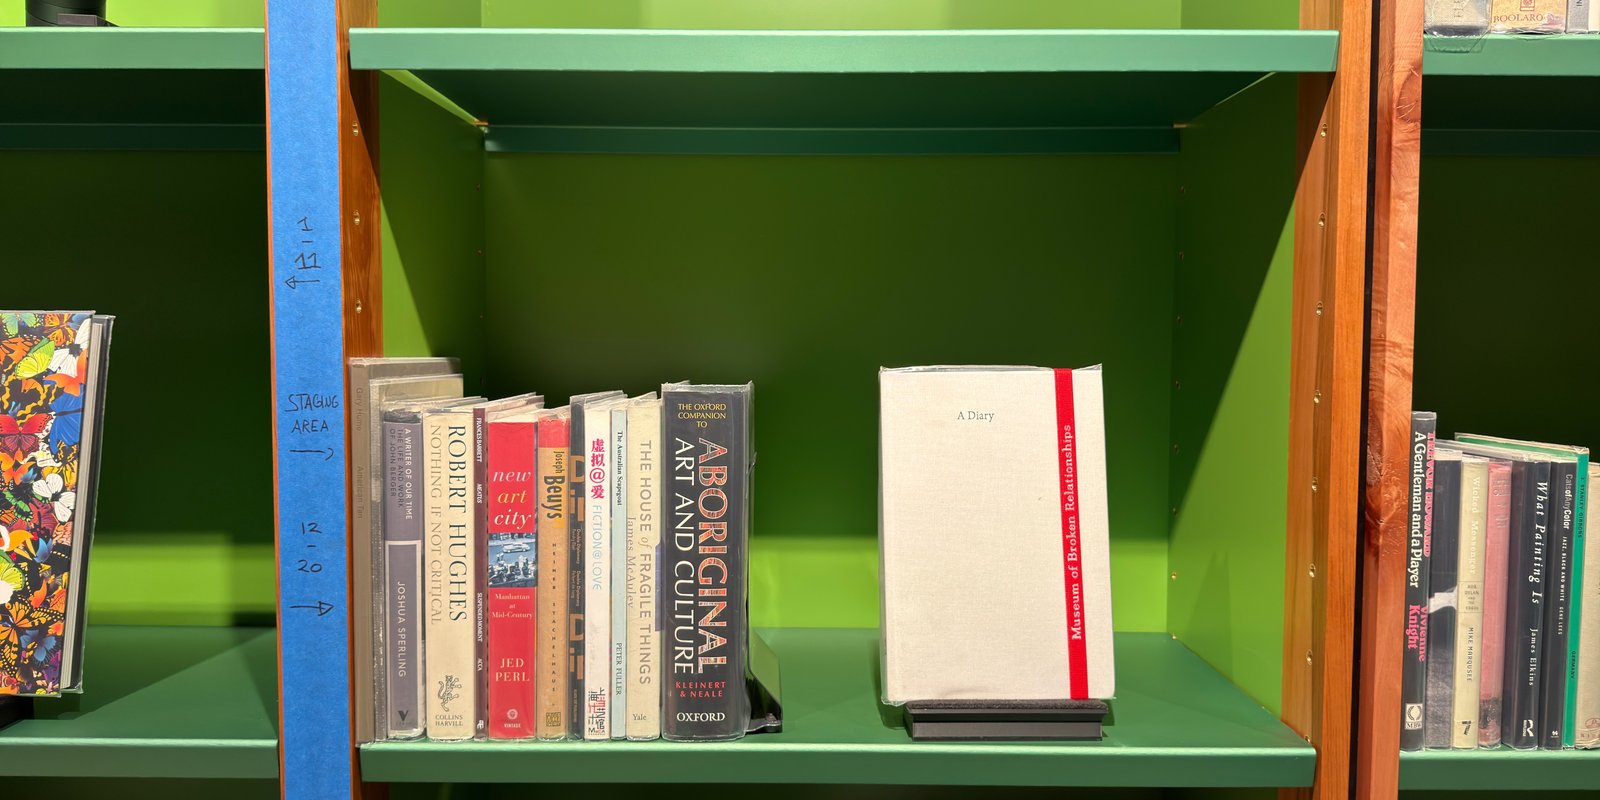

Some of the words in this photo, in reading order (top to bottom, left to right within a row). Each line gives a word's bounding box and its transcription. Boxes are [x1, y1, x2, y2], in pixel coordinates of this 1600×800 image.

[1493, 13, 1546, 23] BOOLARO
[297, 216, 313, 232] 1
[294, 252, 321, 270] 11
[285, 393, 339, 412] STAGING
[678, 403, 693, 411] THE
[693, 403, 727, 411] OXFORD
[291, 419, 329, 433] AREA
[677, 412, 727, 420] COMPANION
[696, 420, 708, 428] TO
[957, 411, 965, 420] A
[967, 410, 995, 423] Diary
[390, 428, 397, 439] OF
[1414, 431, 1427, 443] A
[430, 424, 442, 499] NOTHING
[552, 451, 565, 474] Joseph
[640, 440, 652, 471] THE
[675, 437, 695, 486] ART
[405, 468, 412, 479] OF
[448, 425, 467, 514] ROBERT
[492, 471, 531, 482] new
[589, 438, 605, 499] 虚拟@爱
[1061, 425, 1076, 511] Relationships
[1412, 443, 1427, 512] Gentleman
[405, 481, 413, 499] OUR
[497, 490, 527, 504] art
[541, 475, 566, 519] Beuys
[1471, 476, 1481, 513] Wicked
[1536, 482, 1548, 516] What
[405, 501, 413, 520] TIME
[431, 505, 442, 518] IF
[640, 477, 652, 532] HOUSE
[301, 522, 322, 534] 12
[494, 509, 532, 529] city
[675, 492, 695, 551] AND
[1411, 514, 1423, 538] and
[431, 522, 442, 556] NOT
[627, 517, 636, 552] James
[637, 536, 653, 549] of
[1065, 515, 1078, 562] Broken
[1411, 538, 1420, 547] a
[698, 437, 728, 674] ABORIGINAL
[1467, 520, 1480, 575] Messenger
[1528, 523, 1546, 583] Painting
[297, 559, 322, 573] 20
[448, 523, 468, 622] HUGHES
[1068, 565, 1079, 579] of
[1407, 548, 1423, 588] Player
[430, 559, 442, 625] CRITICAL
[627, 555, 637, 609] McAuley
[639, 553, 651, 618] FRAGILE
[397, 581, 406, 624] JOSHUA
[1532, 590, 1543, 605] Is
[491, 611, 533, 620] Mid-Century
[674, 560, 694, 674] CULTURE
[1071, 583, 1082, 640] Museum
[1405, 604, 1421, 649] Knight
[1418, 604, 1428, 662] Vivienne
[398, 627, 407, 678] SPERLING
[1529, 628, 1538, 653] James
[500, 657, 524, 668] JED
[639, 624, 651, 685] THINGS
[495, 671, 530, 682] PERL
[1529, 657, 1537, 686] Elkins
[675, 681, 727, 689] KLEINERT
[679, 690, 686, 698] &
[690, 690, 723, 698] NEALE
[632, 713, 647, 721] Yale
[676, 712, 726, 722] OXFORD
